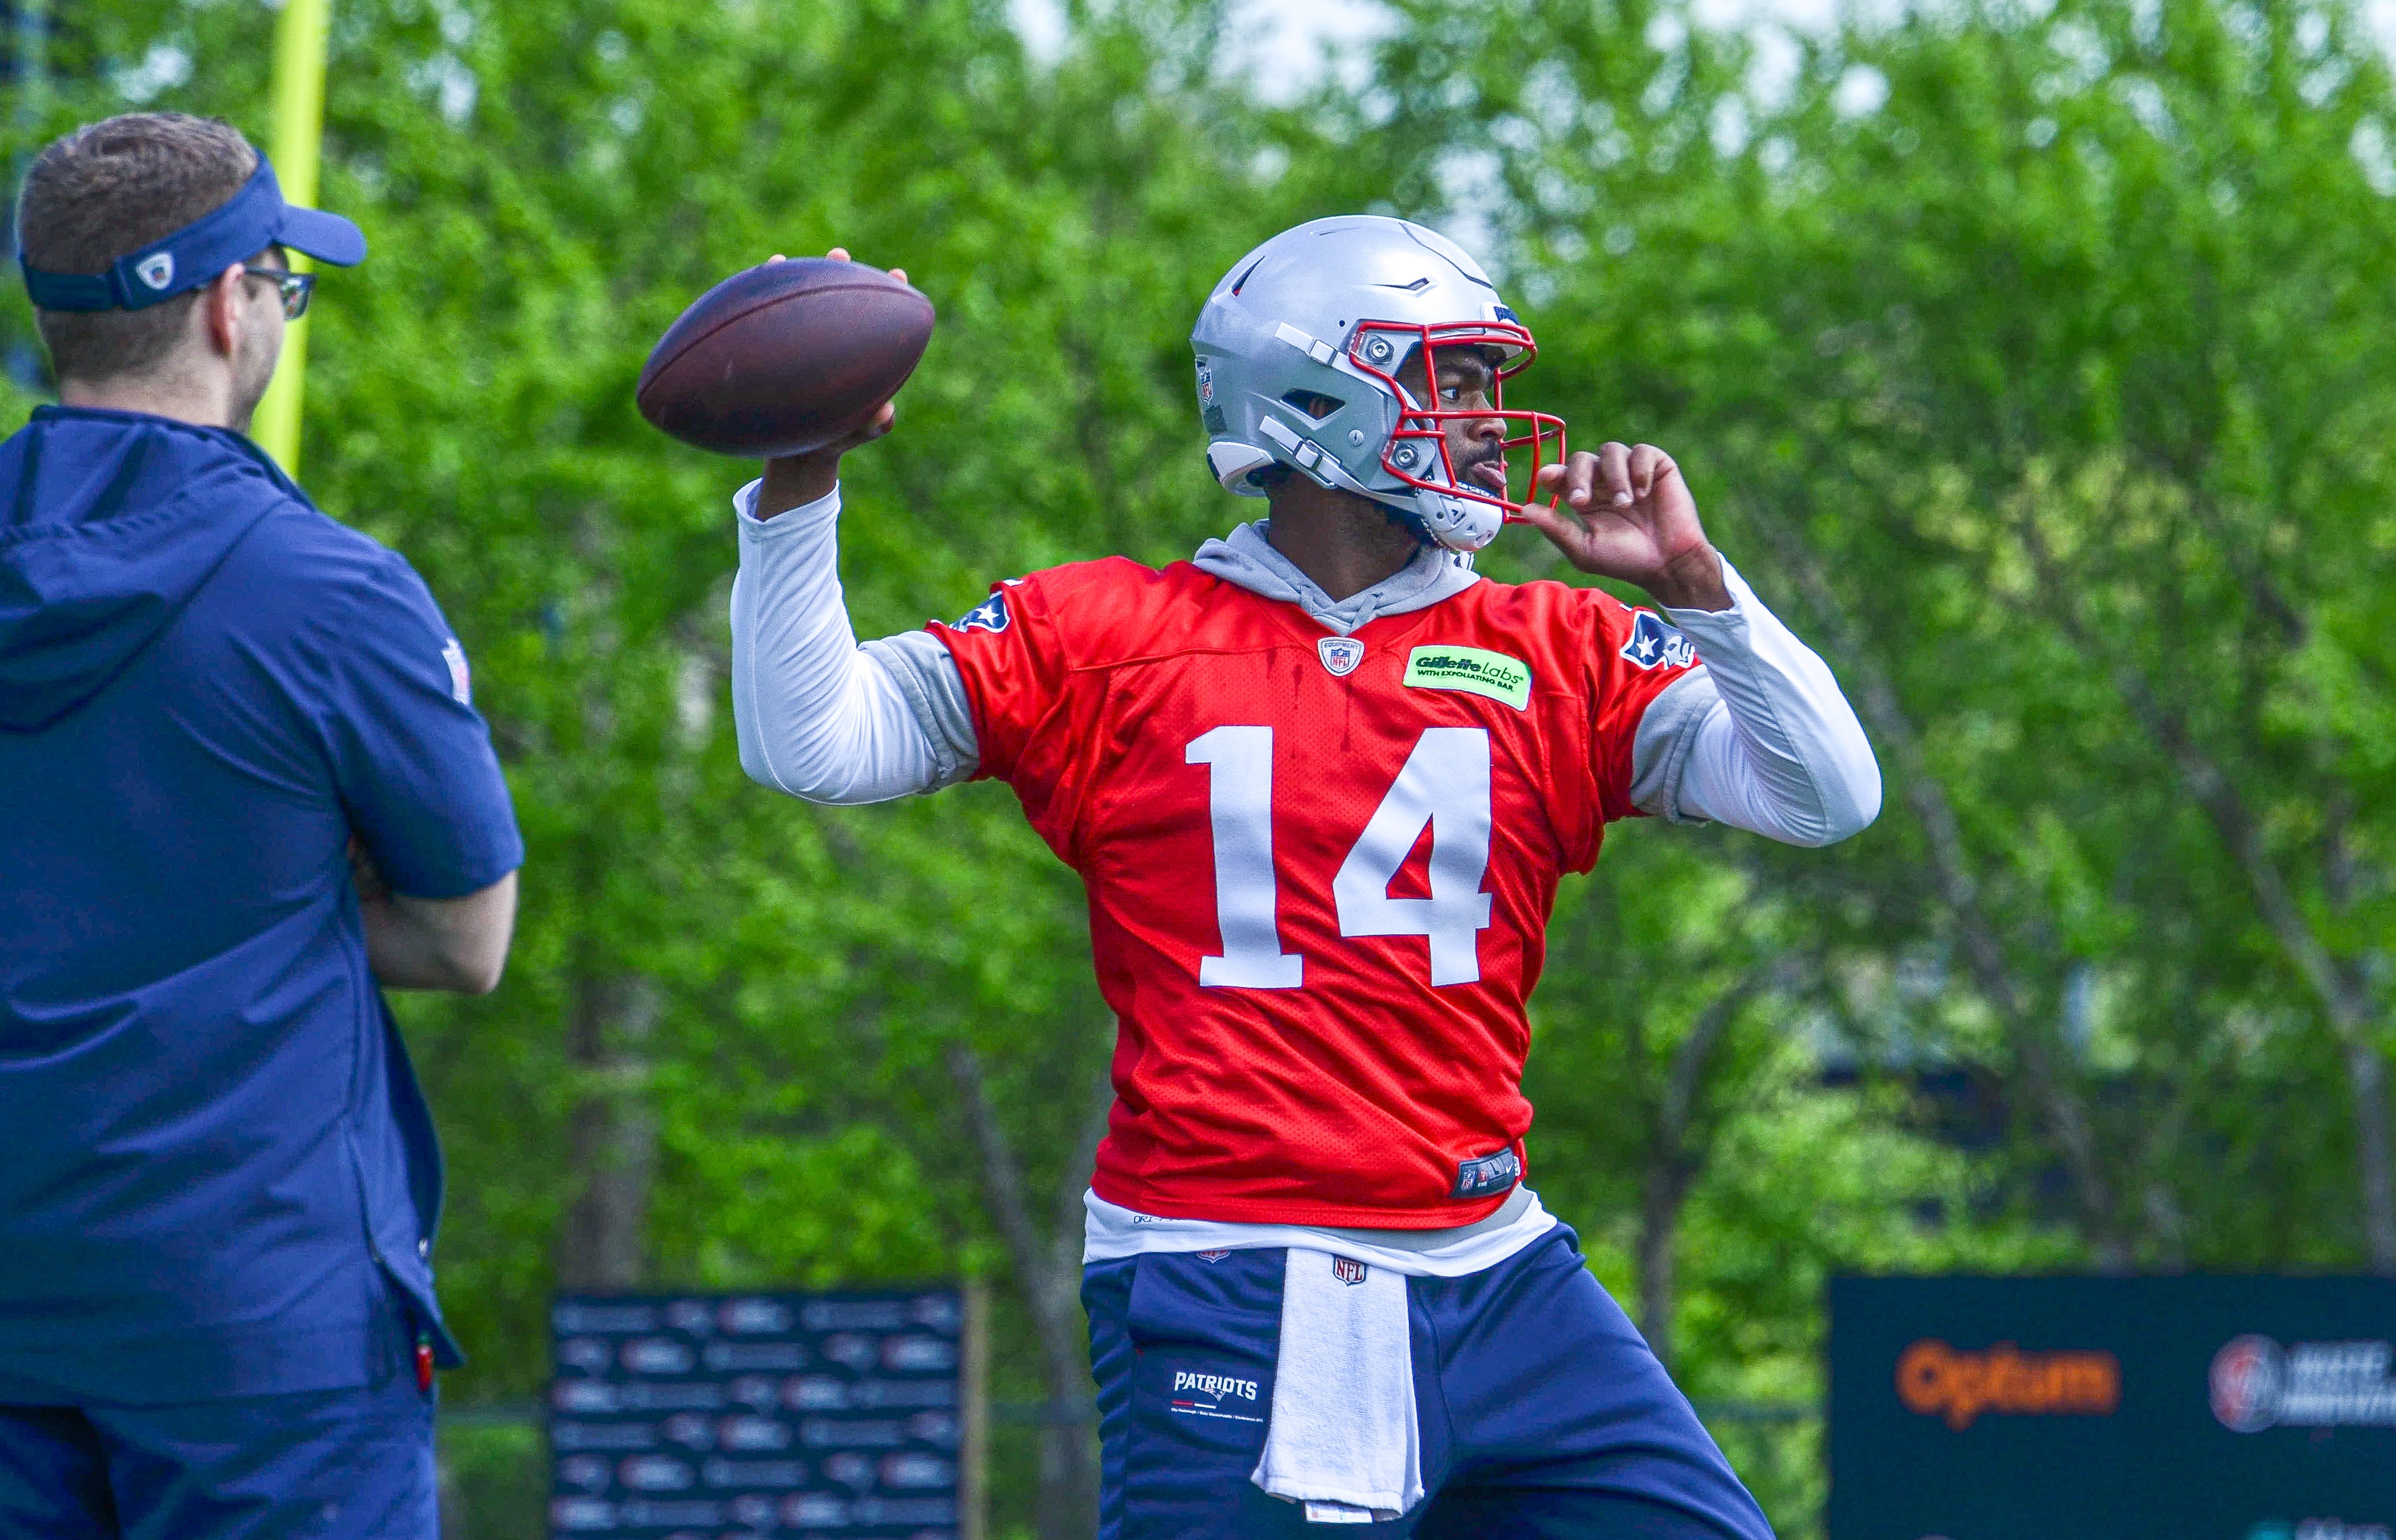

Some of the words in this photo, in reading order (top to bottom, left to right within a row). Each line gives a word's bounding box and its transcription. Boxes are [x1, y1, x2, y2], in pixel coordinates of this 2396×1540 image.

[1332, 657, 1348, 667] NFL
[1441, 670, 1495, 684] EXFOLIATING
[1497, 681, 1514, 692] BAR
[1185, 725, 1493, 988] 14
[1336, 1258, 1363, 1282] NFL
[1174, 1372, 1258, 1401] PATRIOTS
[1898, 1340, 2121, 1430] Optum
